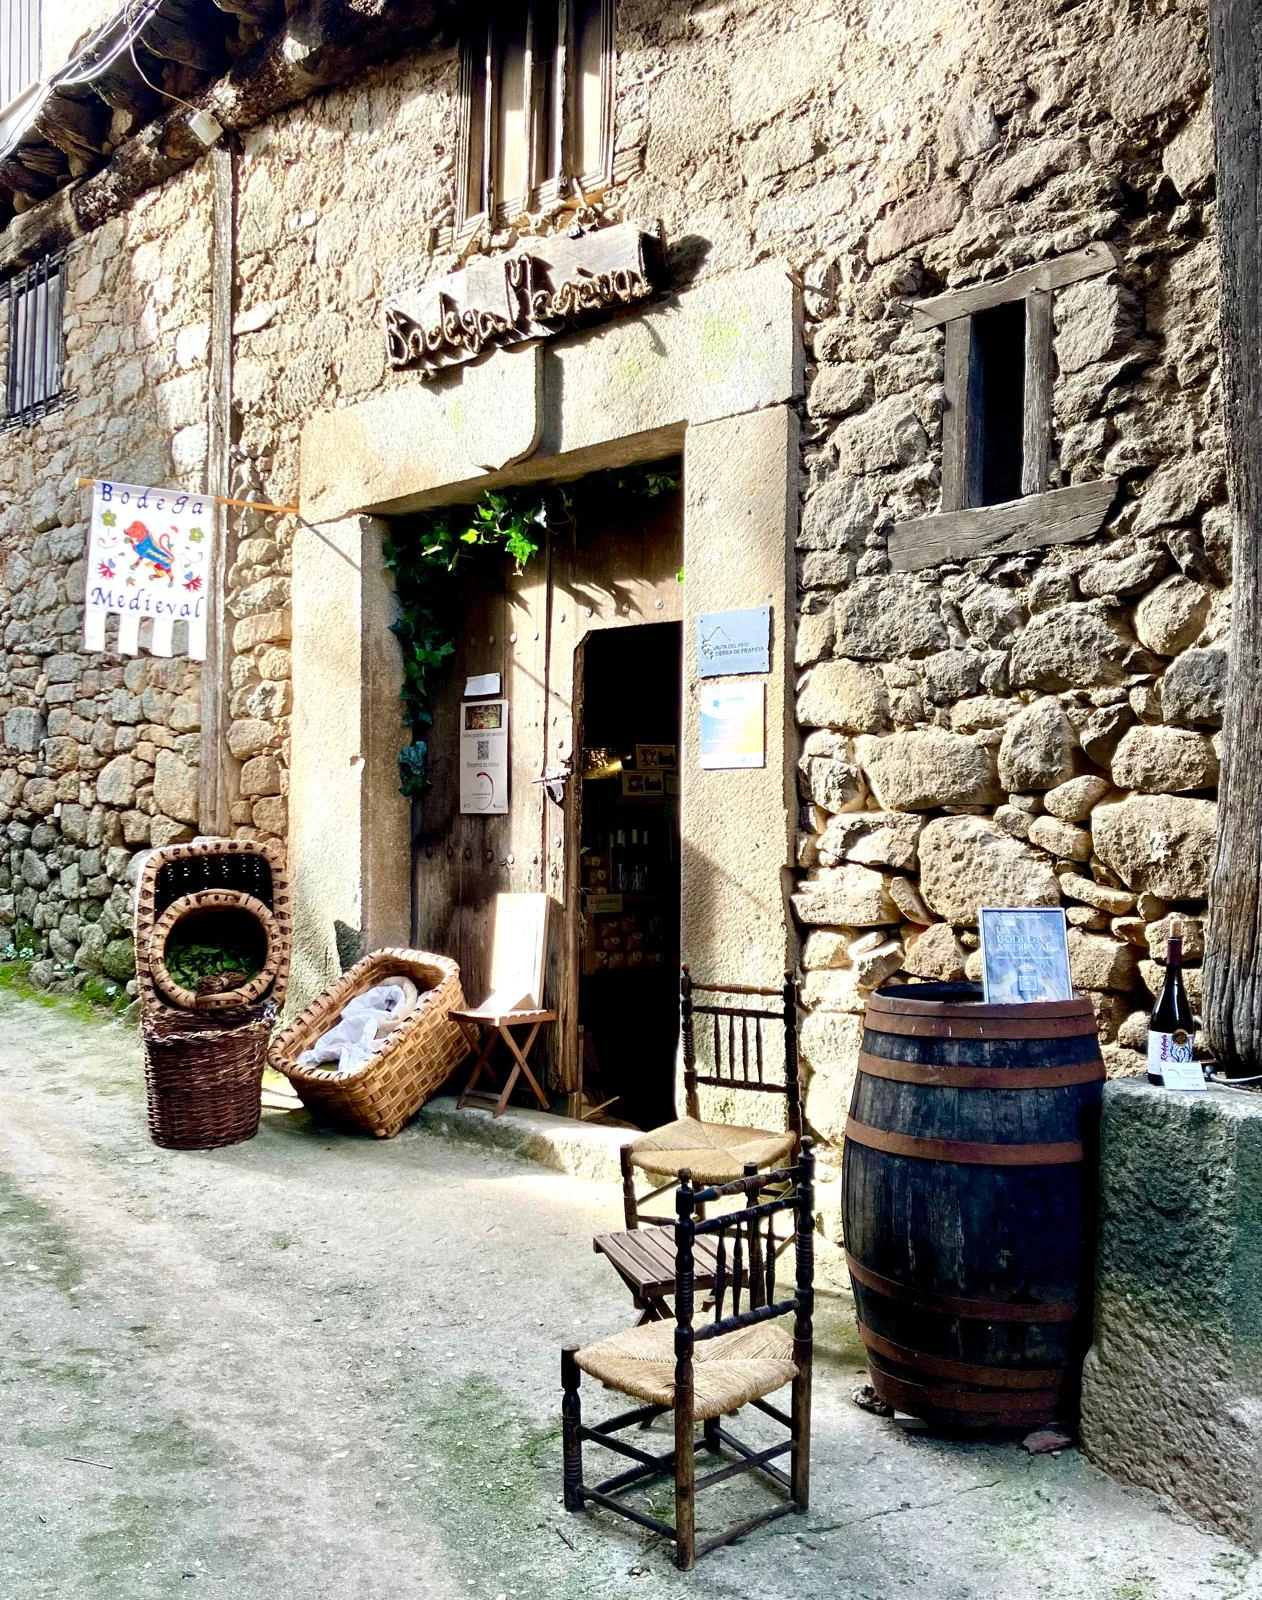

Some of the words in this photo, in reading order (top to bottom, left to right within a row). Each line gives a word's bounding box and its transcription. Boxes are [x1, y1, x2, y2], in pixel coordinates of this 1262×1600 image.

[385, 291, 514, 368] Bodega
[101, 482, 204, 515] Bodega
[91, 586, 205, 619] Medieval
[996, 934, 1045, 944] BODEGA
